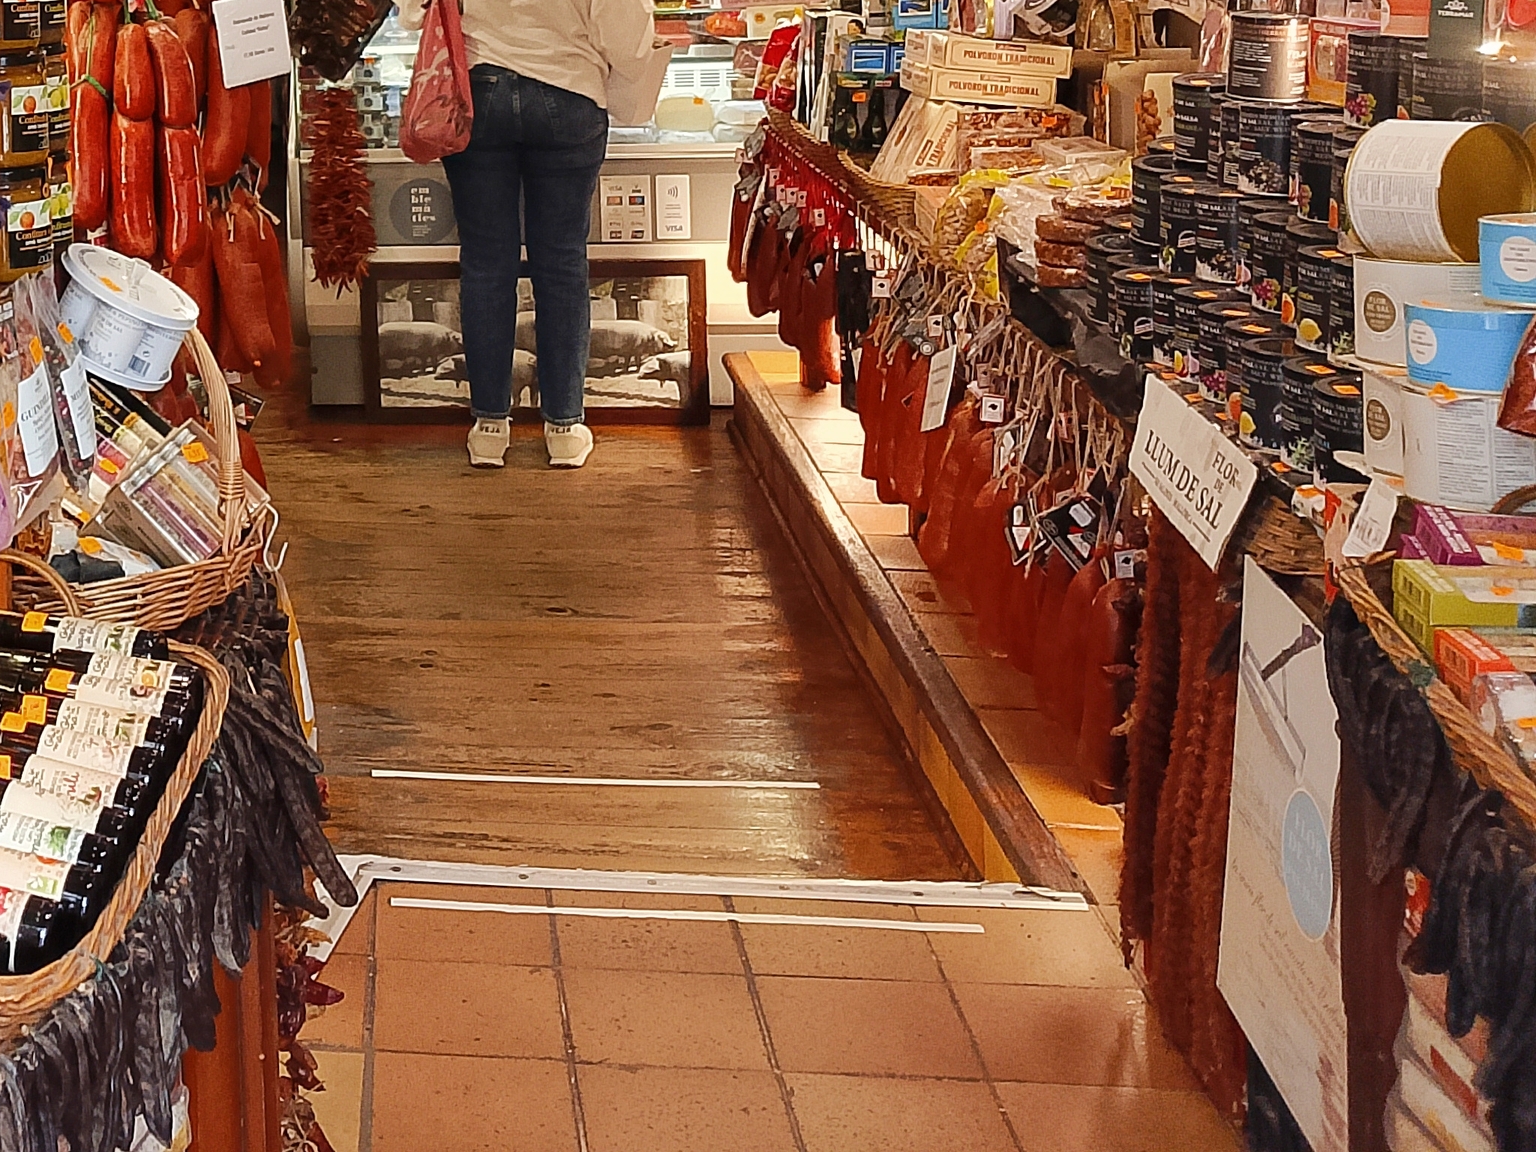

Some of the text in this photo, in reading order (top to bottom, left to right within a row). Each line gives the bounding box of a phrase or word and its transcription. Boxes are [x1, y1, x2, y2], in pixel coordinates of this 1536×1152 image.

[1005, 54, 1056, 67] TRADICIONAL
[989, 84, 1040, 97] TRADICIONAL
[665, 224, 684, 232] VISA
[1212, 451, 1240, 488] FLOR
[1144, 429, 1180, 483] LLUM
[1175, 465, 1200, 503] DE
[1195, 487, 1223, 530] SAL
